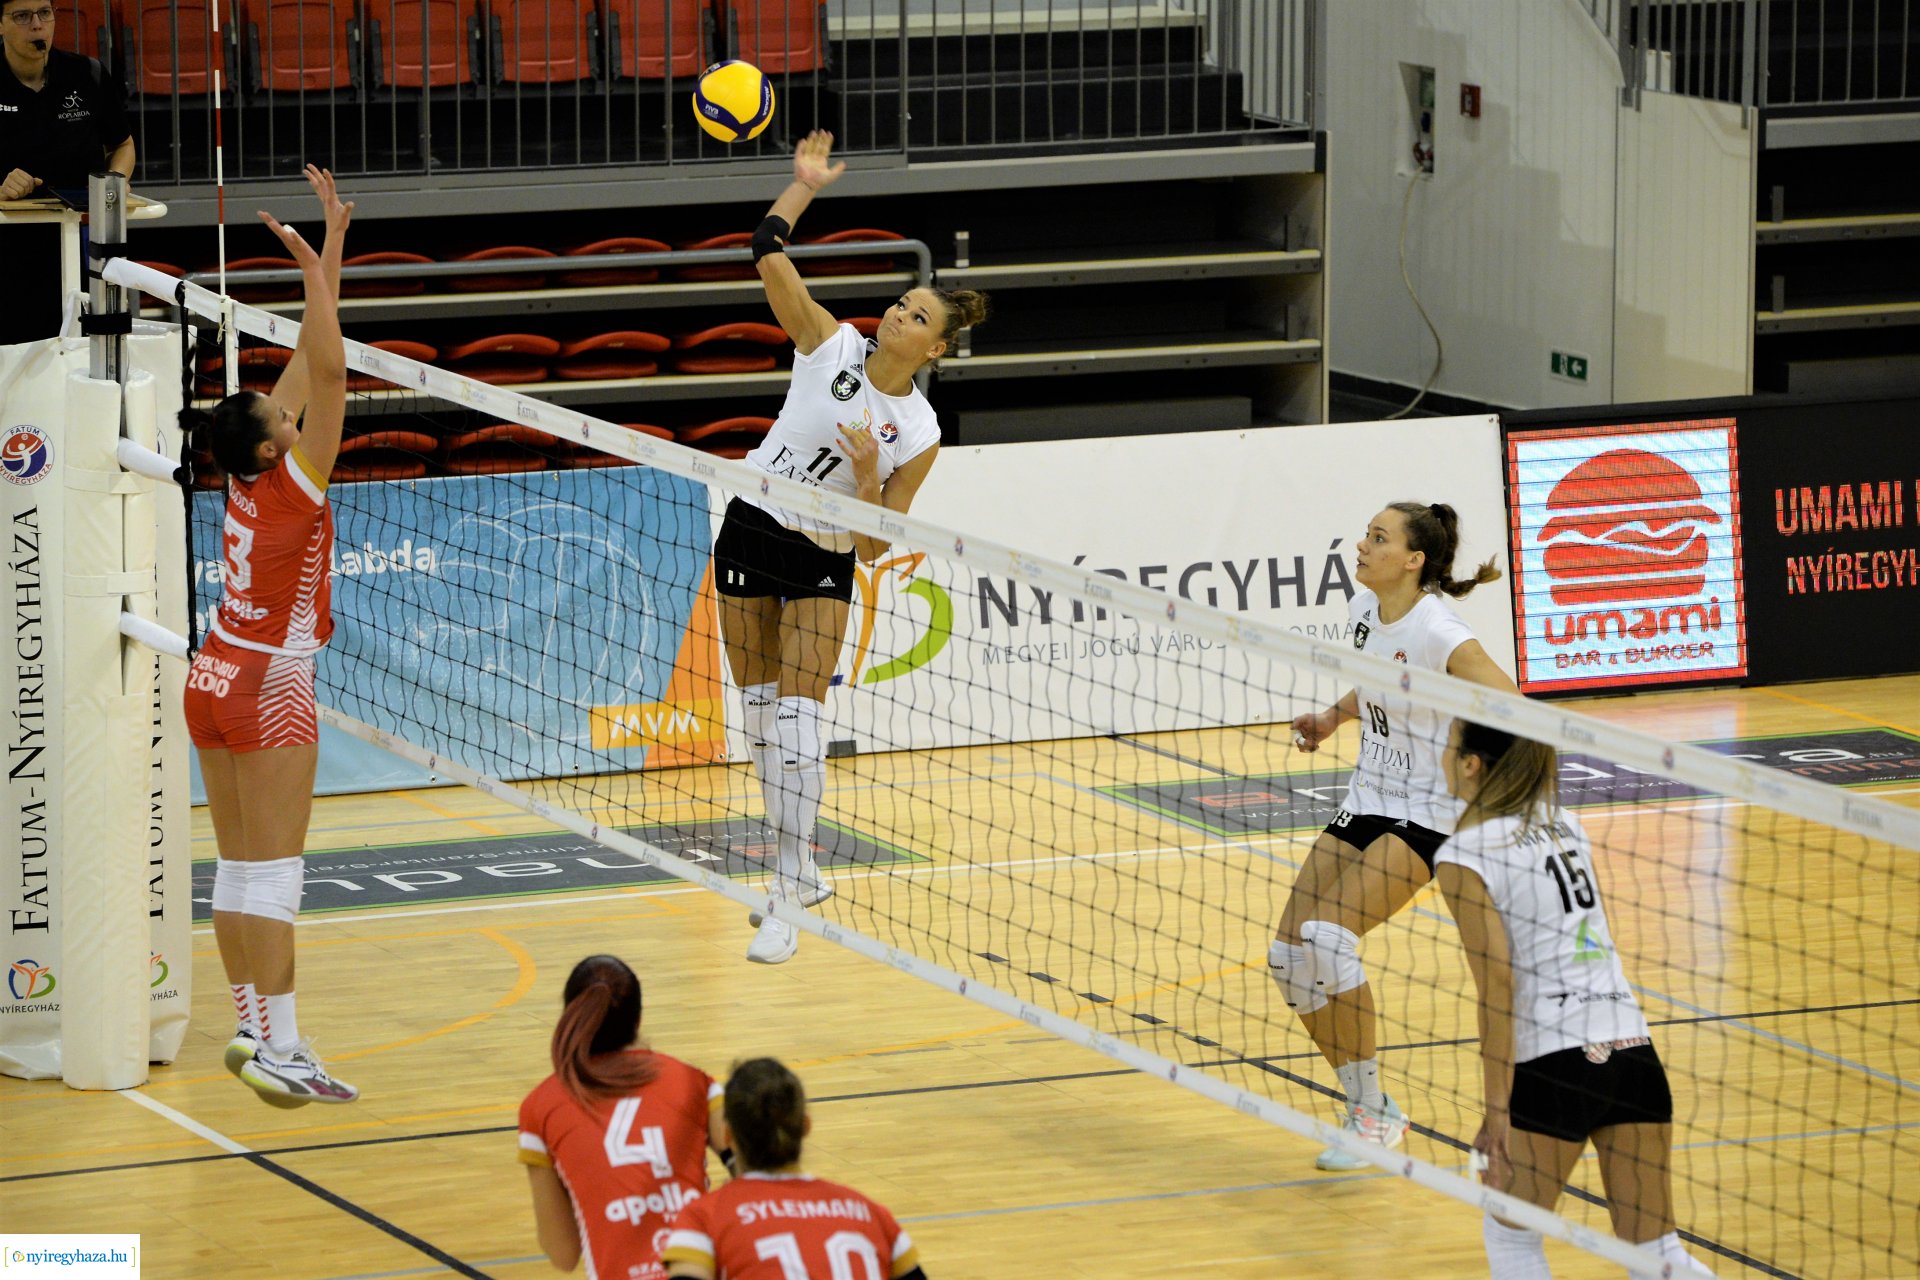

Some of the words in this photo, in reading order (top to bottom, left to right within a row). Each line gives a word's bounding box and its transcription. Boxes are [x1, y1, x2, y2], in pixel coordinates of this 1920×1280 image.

[10, 426, 40, 436] FATUM
[806, 446, 843, 482] 11
[1775, 480, 1902, 536] UMAMI
[223, 511, 254, 592] 3
[977, 538, 1357, 629] NYÍREGYHÁ
[1544, 596, 1721, 646] umami
[982, 641, 1069, 665] MEGYEI
[1079, 632, 1141, 659] JOGÚ
[1555, 650, 1601, 669] BAR
[1625, 641, 1715, 664] BURGER
[611, 709, 701, 740] MVM
[1366, 701, 1389, 738] 19
[1545, 849, 1596, 914] 15
[0, 1003, 60, 1014] NYÍREGYHÁZ
[603, 1097, 673, 1179] 4
[754, 1231, 883, 1280] 10
